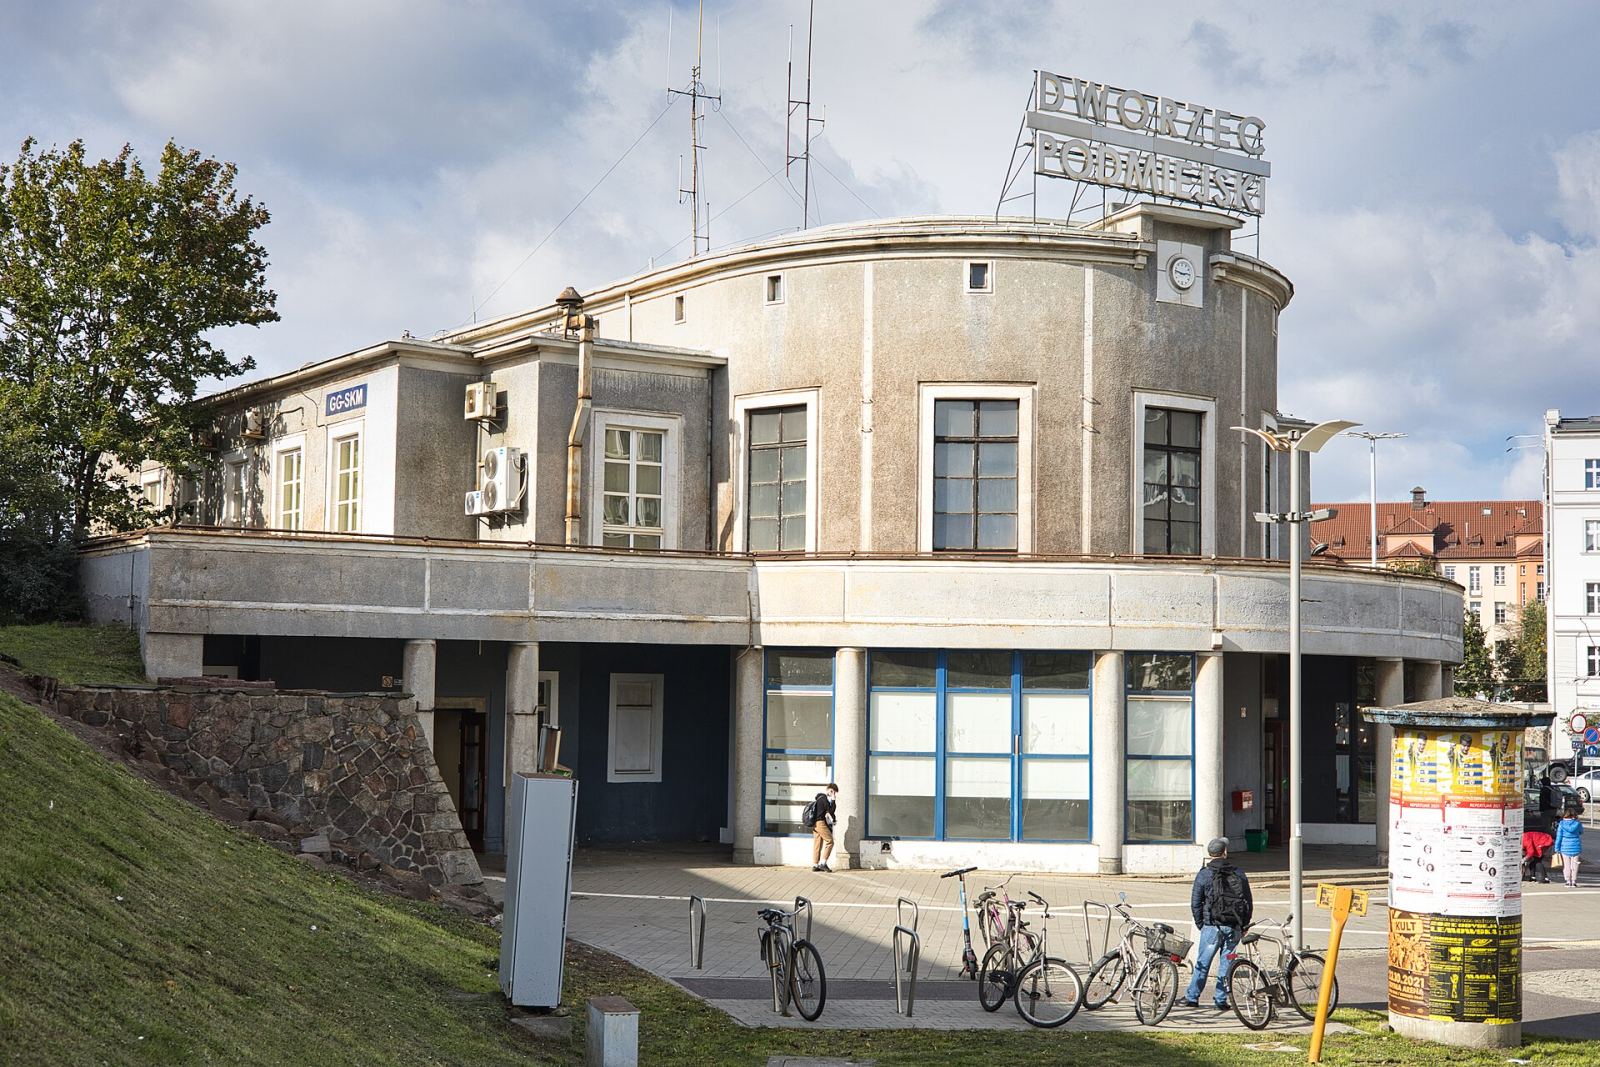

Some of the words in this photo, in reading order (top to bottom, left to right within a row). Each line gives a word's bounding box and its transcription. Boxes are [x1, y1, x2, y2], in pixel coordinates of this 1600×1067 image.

[1036, 70, 1266, 155] DWORZEC
[1036, 130, 1266, 214] PODMIEJSKI
[330, 388, 363, 411] GG-SKM
[1395, 921, 1416, 931] KULT
[1403, 985, 1424, 996] ARENA
